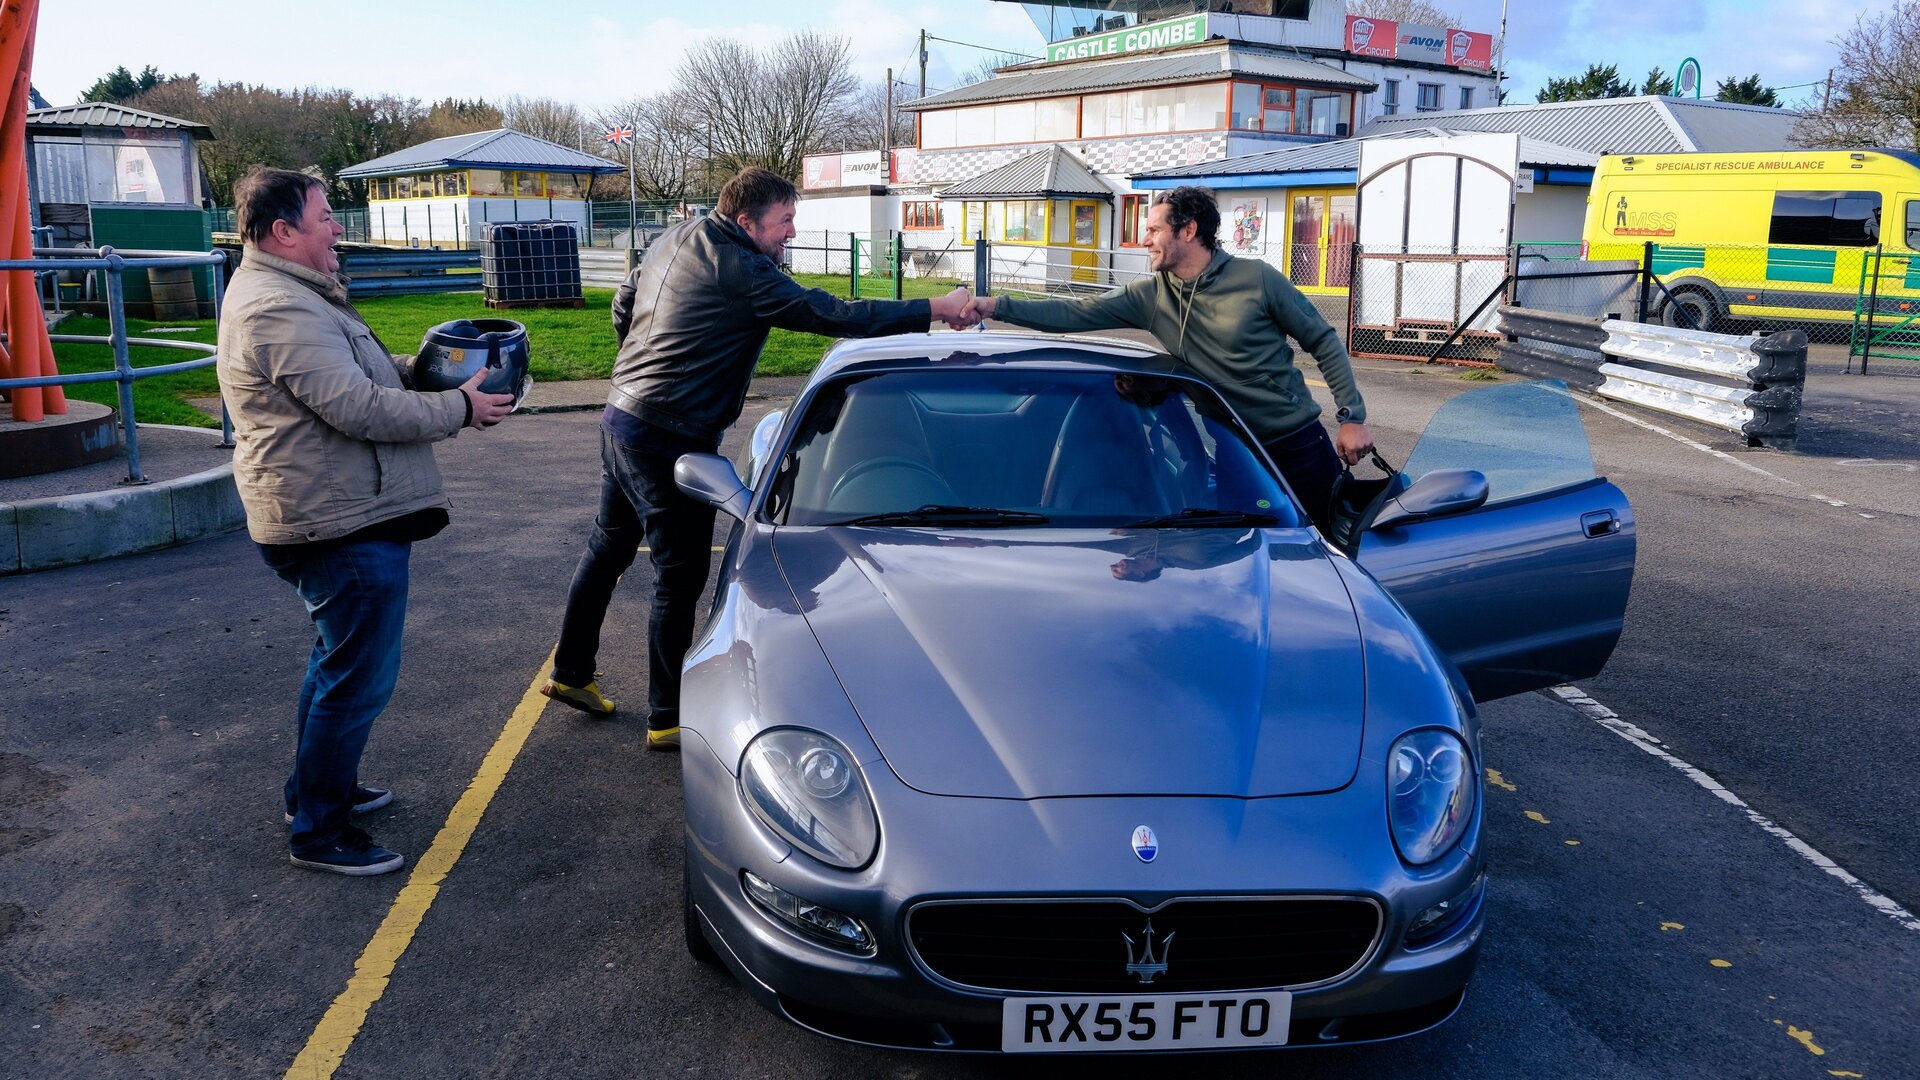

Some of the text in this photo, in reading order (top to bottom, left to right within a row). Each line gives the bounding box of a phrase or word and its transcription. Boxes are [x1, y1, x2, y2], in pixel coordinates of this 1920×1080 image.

[1054, 21, 1197, 61] CASTLE COMBE
[1408, 36, 1444, 48] AVON
[1365, 46, 1391, 57] CIRCUIT
[1463, 58, 1486, 69] CIRCUIT
[850, 162, 879, 172] AVON
[1655, 160, 1826, 171] SPECIALIST RESCUE AMBULANCE
[1628, 211, 1678, 232] MSS
[1024, 998, 1270, 1043] RX55 FTO
